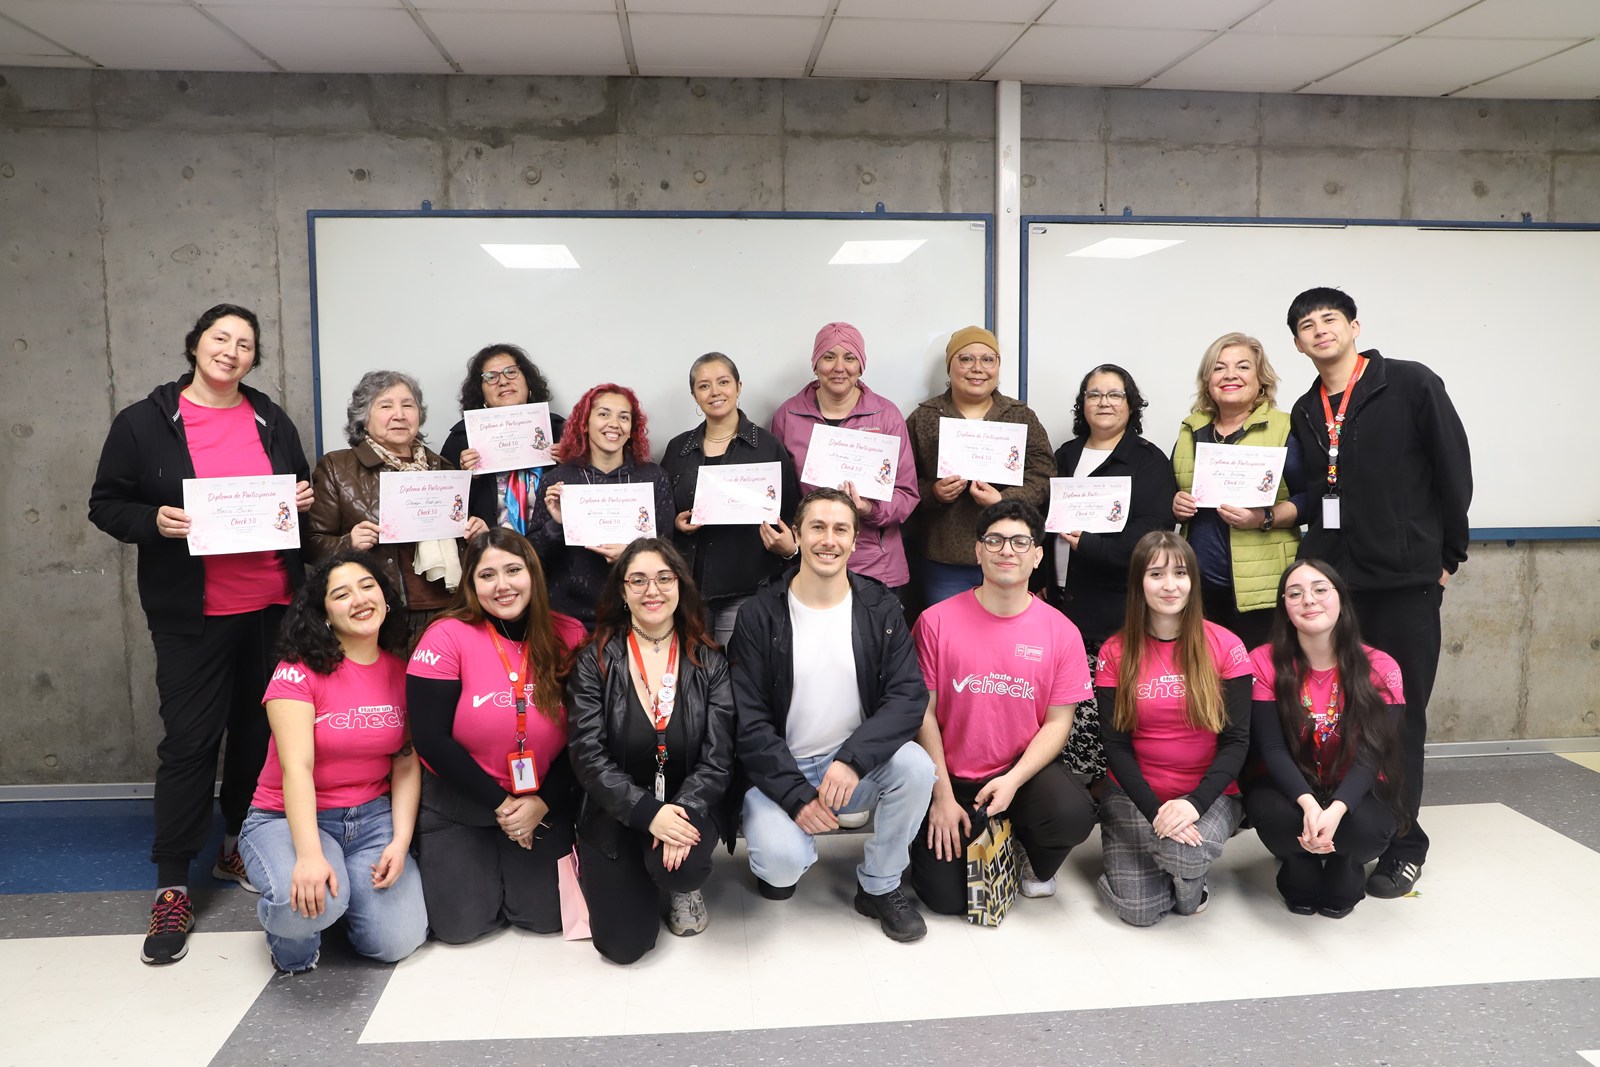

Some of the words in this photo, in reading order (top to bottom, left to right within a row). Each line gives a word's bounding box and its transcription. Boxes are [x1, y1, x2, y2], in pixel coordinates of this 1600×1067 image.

[208, 492, 232, 502] Diploma
[990, 672, 1012, 682] hazte
[968, 676, 1034, 700] check
[1136, 679, 1186, 699] che
